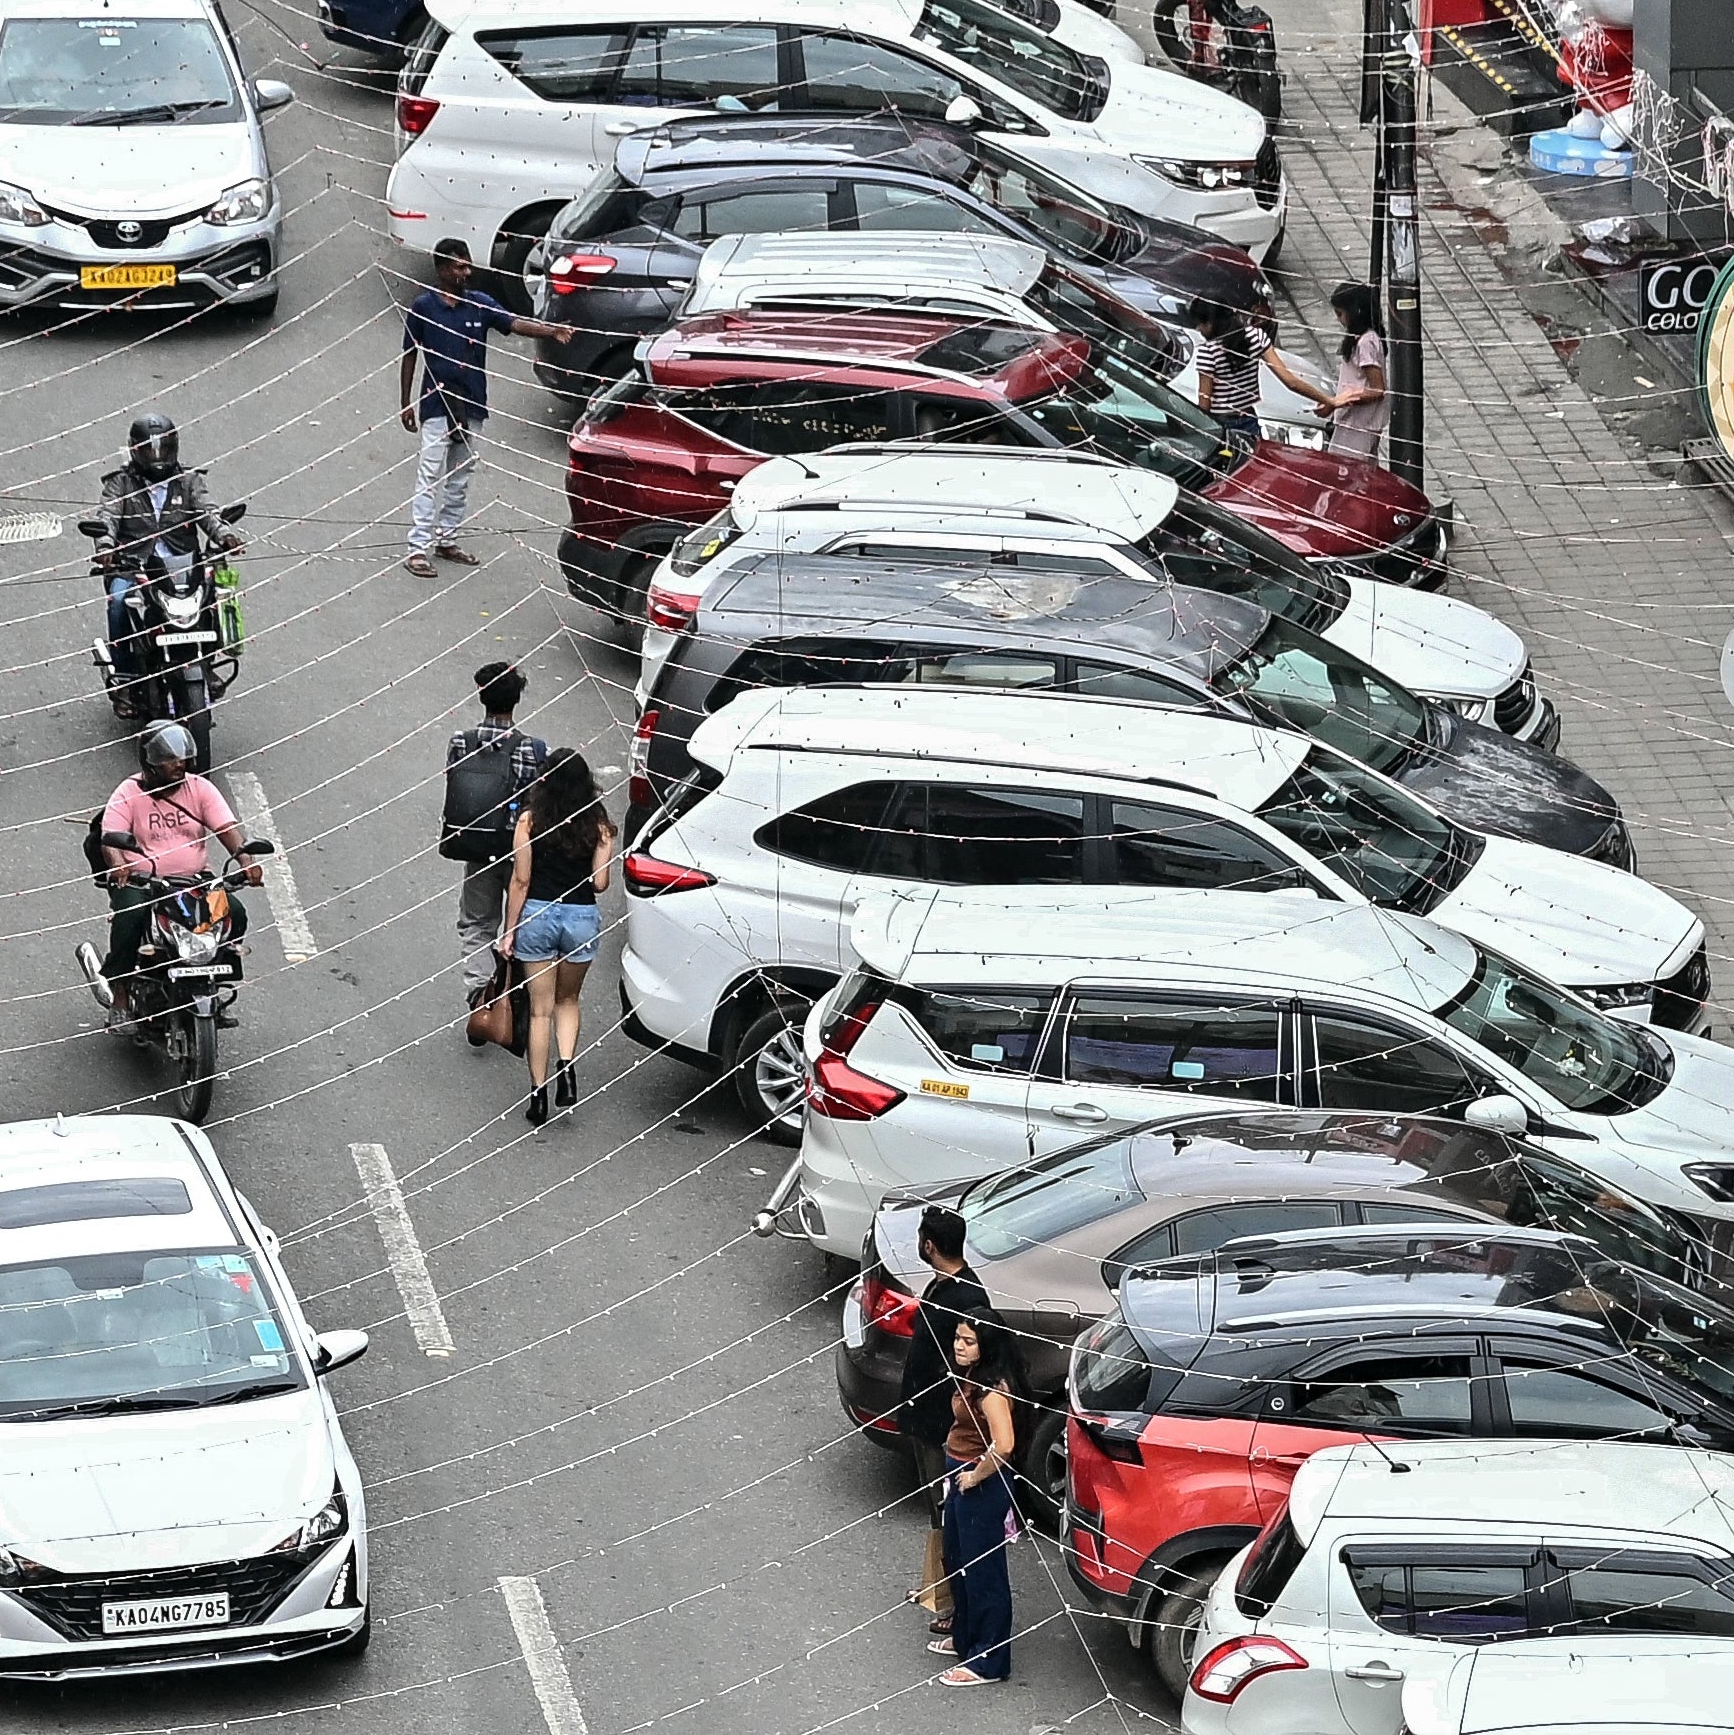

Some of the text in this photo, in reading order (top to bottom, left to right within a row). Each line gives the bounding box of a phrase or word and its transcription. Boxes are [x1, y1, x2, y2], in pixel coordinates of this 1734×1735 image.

[1647, 264, 1720, 310] GO
[1647, 311, 1699, 332] COLO
[148, 810, 190, 832] RISE
[115, 1599, 227, 1628] KA04NG7785
